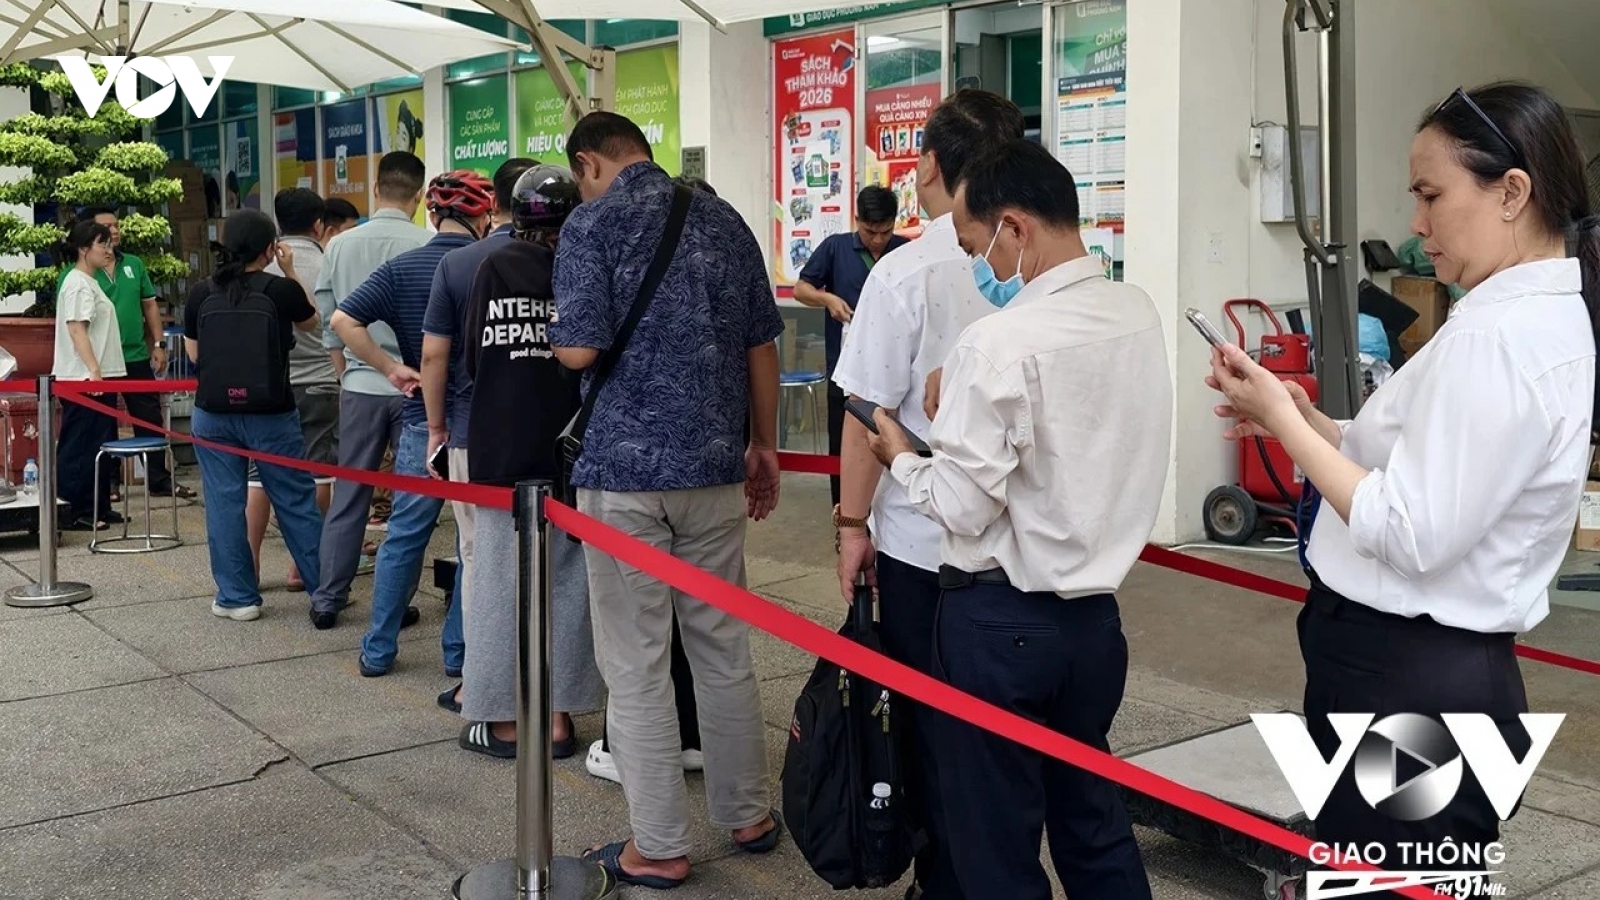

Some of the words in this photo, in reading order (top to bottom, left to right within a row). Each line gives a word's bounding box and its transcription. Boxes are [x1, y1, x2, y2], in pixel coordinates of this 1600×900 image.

[801, 54, 832, 73] SÁCH
[1094, 45, 1120, 65] MUA
[785, 73, 816, 93] THAM
[817, 66, 848, 86] KHẢO
[799, 88, 833, 108] 2026
[876, 103, 890, 113] MUA
[891, 99, 910, 111] CÀNG
[455, 139, 476, 160] CHẤT
[478, 139, 507, 160] LƯỢNG
[526, 131, 552, 157] HIỆU
[510, 347, 529, 360] good
[228, 387, 247, 397] ONE
